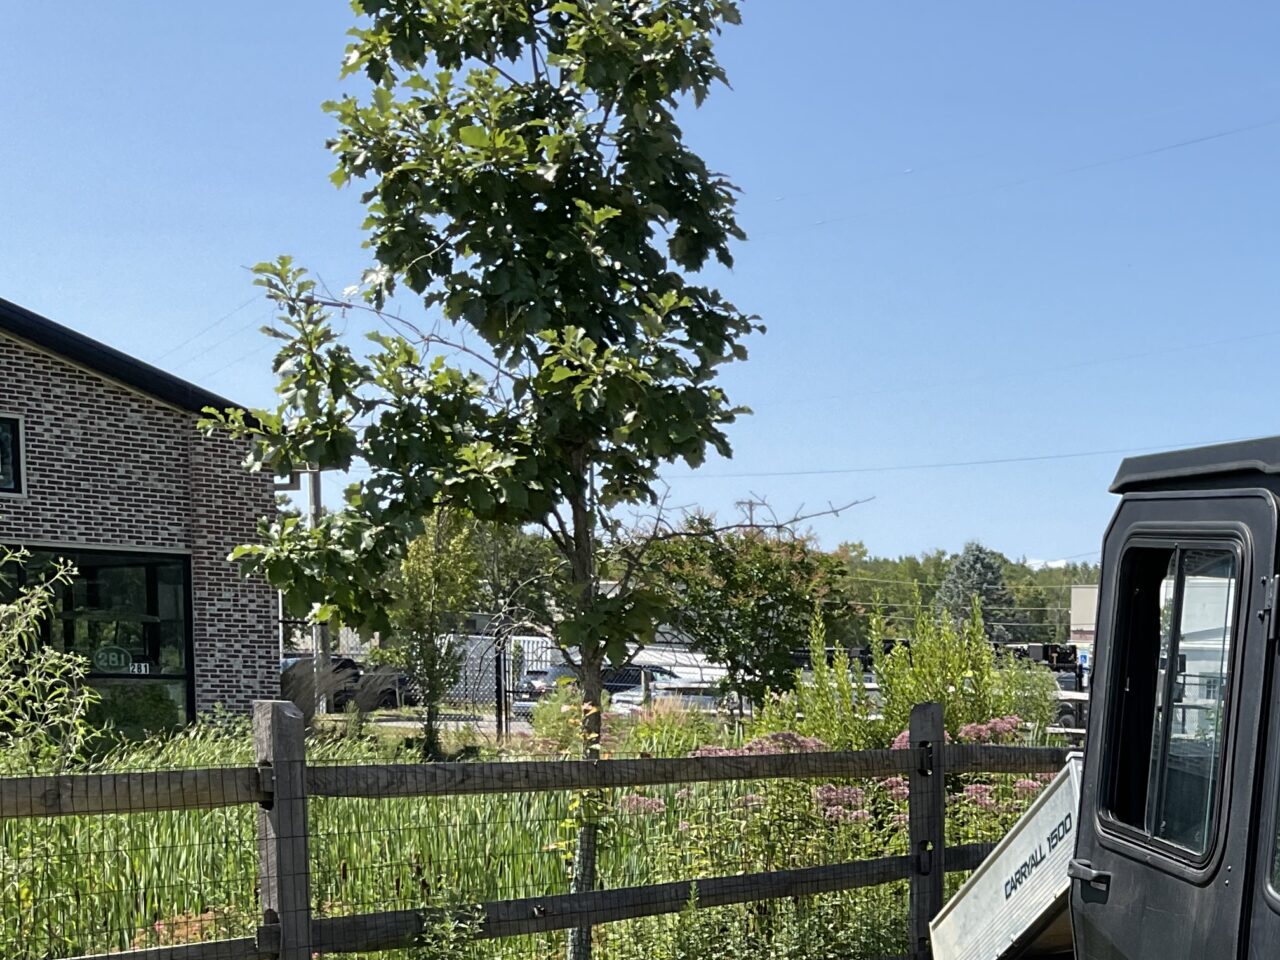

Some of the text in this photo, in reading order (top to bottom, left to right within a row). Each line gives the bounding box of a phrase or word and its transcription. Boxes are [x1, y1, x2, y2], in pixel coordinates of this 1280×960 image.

[98, 652, 126, 667] 281
[130, 663, 149, 674] 281
[1004, 812, 1073, 900] CARRYALL 1500
